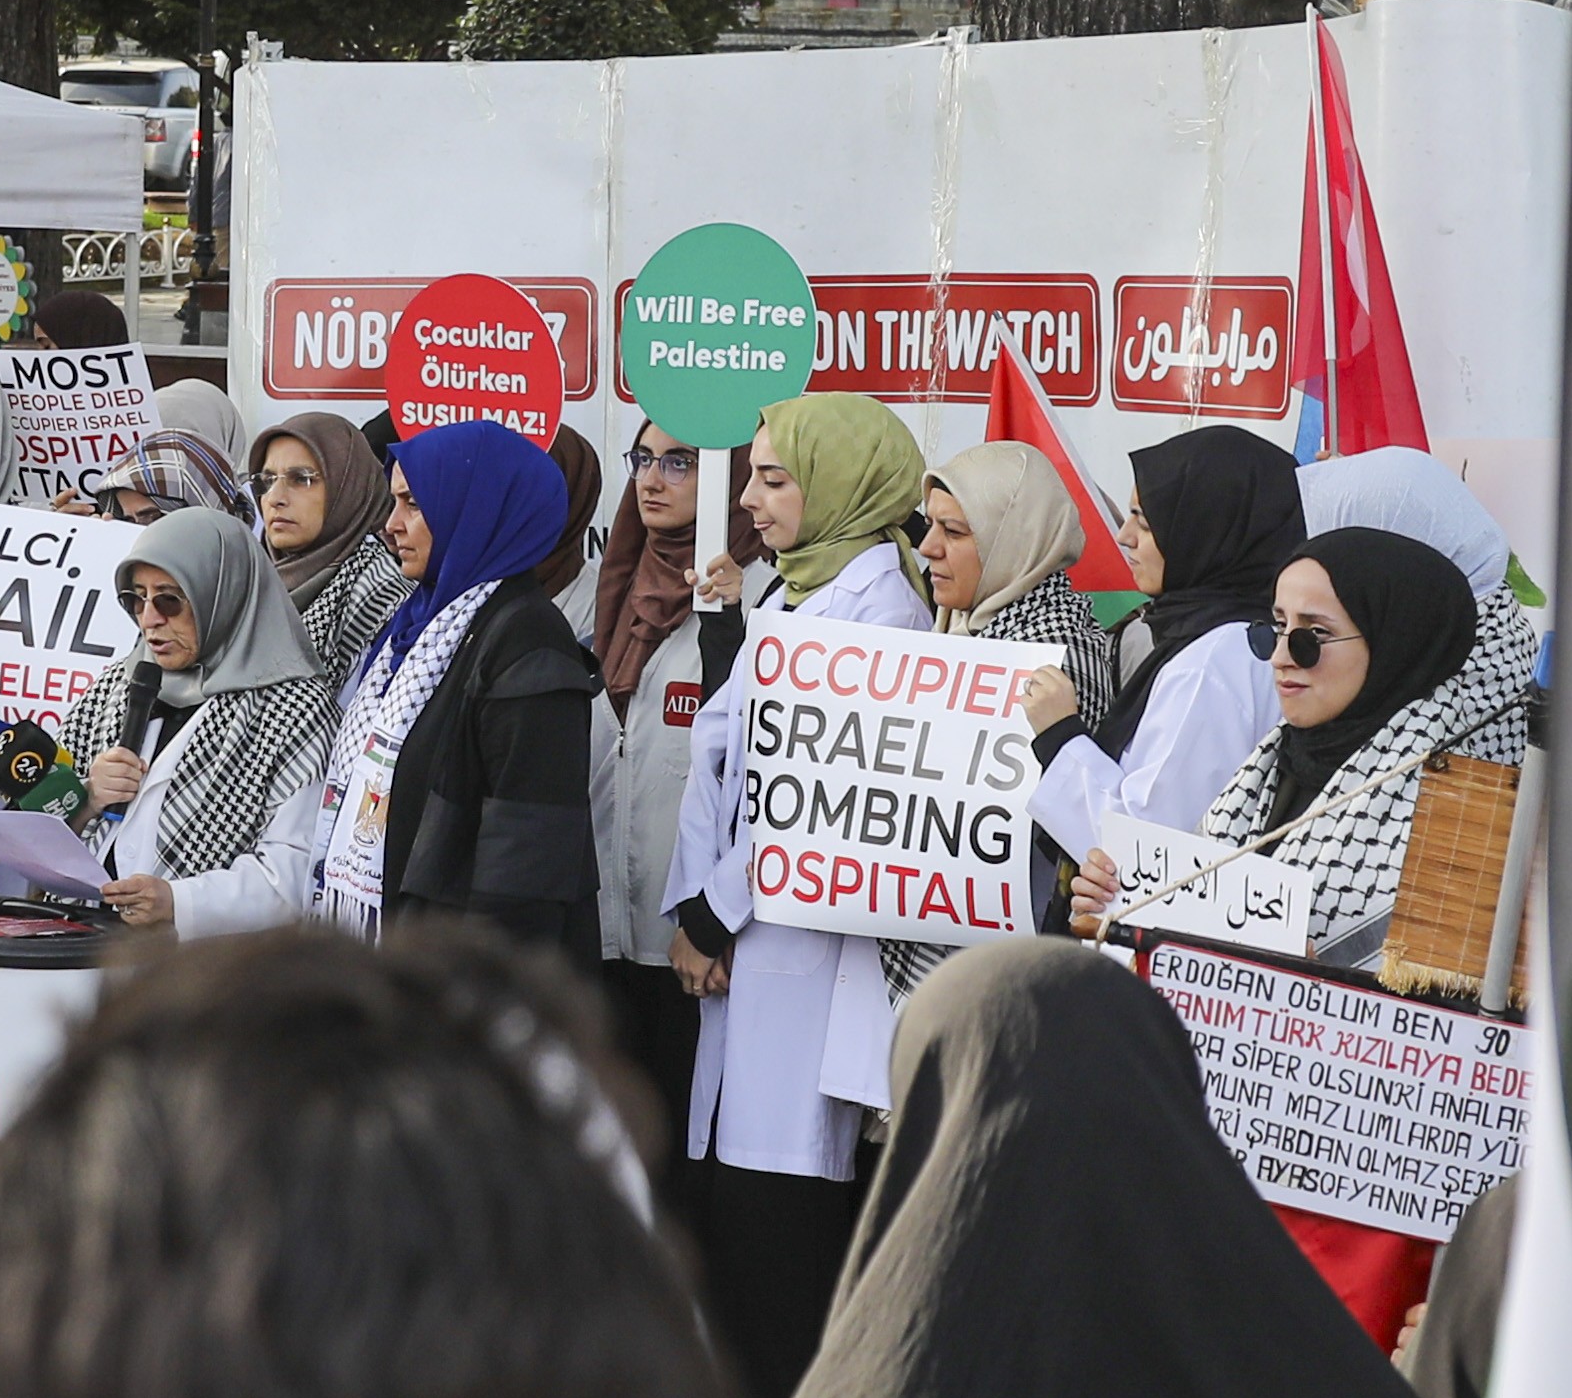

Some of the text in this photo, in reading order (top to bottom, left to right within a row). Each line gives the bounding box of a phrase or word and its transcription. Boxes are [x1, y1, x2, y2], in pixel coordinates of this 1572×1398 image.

[413, 319, 534, 351] Çocuklar
[635, 295, 806, 327] Will Be Free
[874, 310, 936, 372] THE
[947, 309, 1081, 374] WATCH
[1123, 305, 1278, 387] مرابطون
[420, 355, 527, 394] Ölürken
[650, 340, 786, 371] Palestine
[9, 389, 144, 411] PEOPLE DIED
[11, 411, 150, 432] CCUPIER ISRAEL
[666, 695, 700, 715] AID
[747, 698, 1031, 791] ISRAEL IS
[746, 769, 1012, 865] BOMBING
[752, 842, 1014, 932] OSPITAL!
[1226, 873, 1292, 930] المحتل
[1151, 952, 1511, 1057] ERDOĞAN OĞLUM BEN 90
[1232, 1040, 1301, 1082] SİPER
[1309, 1062, 1426, 1112] OLSUNKİ
[1430, 1091, 1532, 1134] ANALAR
[1252, 1007, 1326, 1052] TÜRK
[1330, 1031, 1462, 1086] KIZILAYA
[1470, 1061, 1535, 1101] BEDE
[1205, 1070, 1273, 1111] MUNA
[1285, 1091, 1472, 1159] MAZLUMLARDA
[1206, 1105, 1241, 1138] Kİ
[1246, 1117, 1353, 1168] ŞABDAN
[1441, 1166, 1508, 1199] ŞEK
[1257, 1154, 1472, 1227] AYASOFYANIN PA
